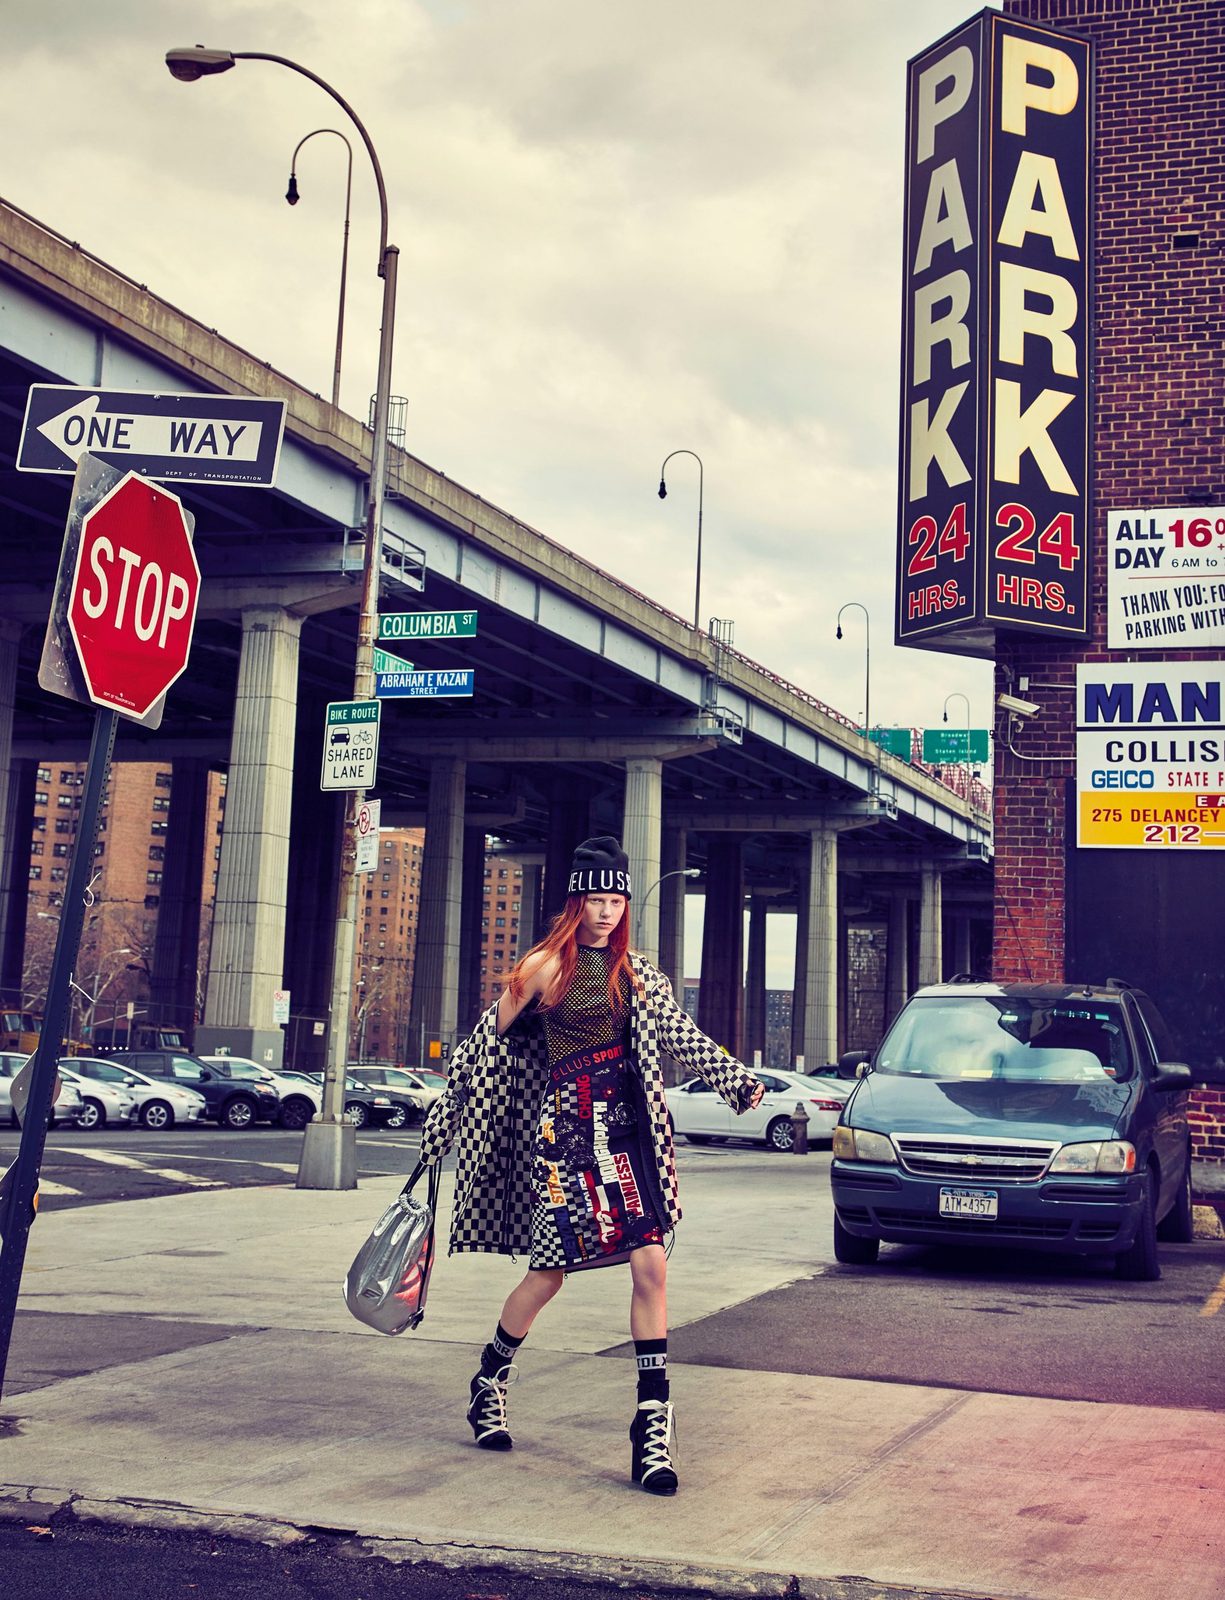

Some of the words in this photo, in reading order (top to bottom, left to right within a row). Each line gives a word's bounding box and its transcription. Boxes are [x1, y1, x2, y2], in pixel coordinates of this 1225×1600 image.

[910, 45, 974, 502] PARK
[994, 34, 1080, 497] PARK
[63, 414, 134, 449] ONE
[170, 421, 247, 456] WAY
[204, 473, 262, 481] TRANSPORTATION
[907, 502, 970, 576] 24
[995, 502, 1080, 572] 24
[1116, 518, 1163, 541] ALL
[1115, 546, 1165, 569] DAY
[1206, 557, 1218, 567] to
[83, 536, 190, 649] STOP
[908, 579, 966, 620] HRS.
[996, 573, 1075, 614] HRS.
[1121, 589, 1170, 617] THANK
[1174, 584, 1208, 609] YOU:
[382, 615, 457, 636] COLUMBIA
[462, 614, 473, 625] ST
[1125, 614, 1186, 641] PARKING
[380, 673, 425, 688] ABRAHAM
[427, 673, 434, 687] E
[436, 672, 468, 687] KAZAN
[410, 687, 438, 695] STREET
[330, 709, 348, 721] BIKE
[351, 707, 377, 720] ROUTE
[1084, 682, 1221, 723] MAN
[327, 747, 373, 762] SHARED
[333, 765, 365, 779] LANE
[1091, 770, 1154, 788] GEICO
[1168, 771, 1209, 787] STATE
[1092, 808, 1122, 822] 275
[1130, 808, 1220, 822] DELANCEY
[552, 1056, 591, 1081] ELLUS
[592, 1046, 623, 1064] SPORT
[576, 1074, 592, 1119] CHANG
